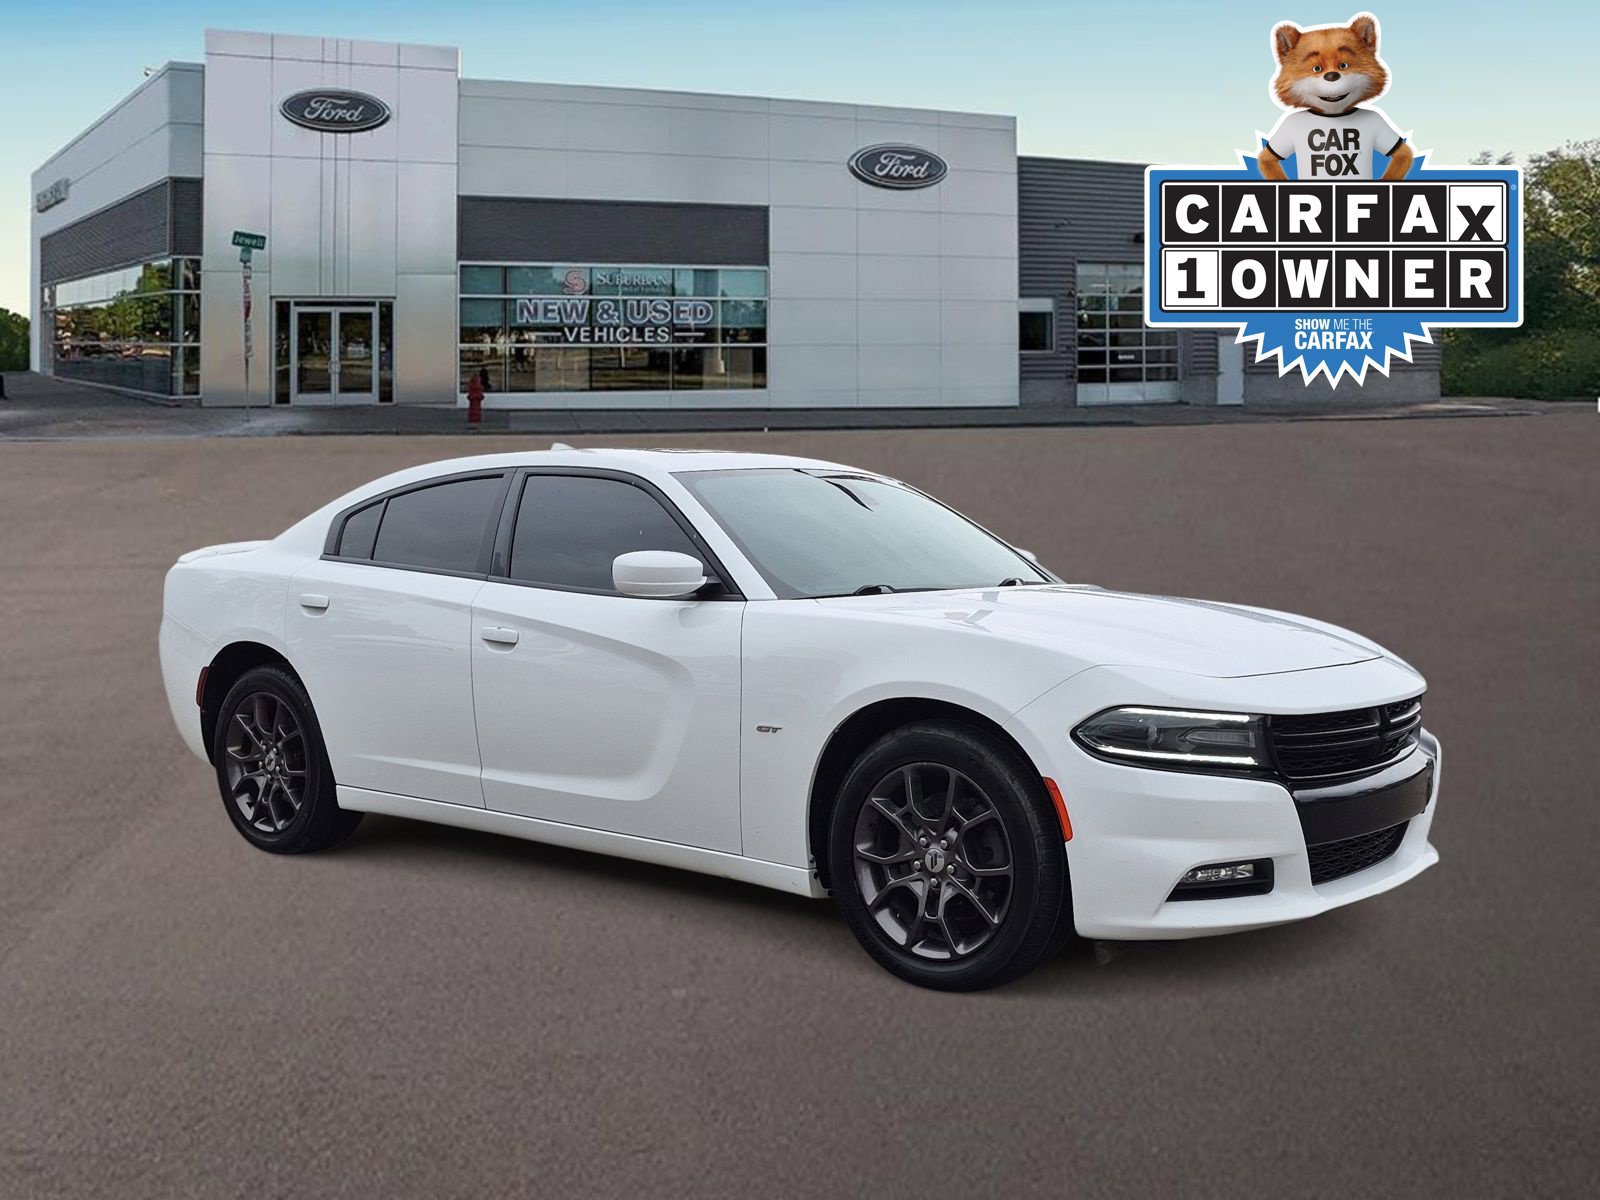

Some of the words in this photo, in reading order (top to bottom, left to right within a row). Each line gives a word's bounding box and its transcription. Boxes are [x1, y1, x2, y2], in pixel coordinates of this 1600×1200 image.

[304, 96, 364, 121] Ford
[875, 152, 930, 178] Ford
[516, 299, 589, 324] NEW
[596, 299, 619, 324] &
[626, 299, 714, 324] USED
[563, 326, 670, 343] VEHICLES
[756, 725, 782, 733] GT
